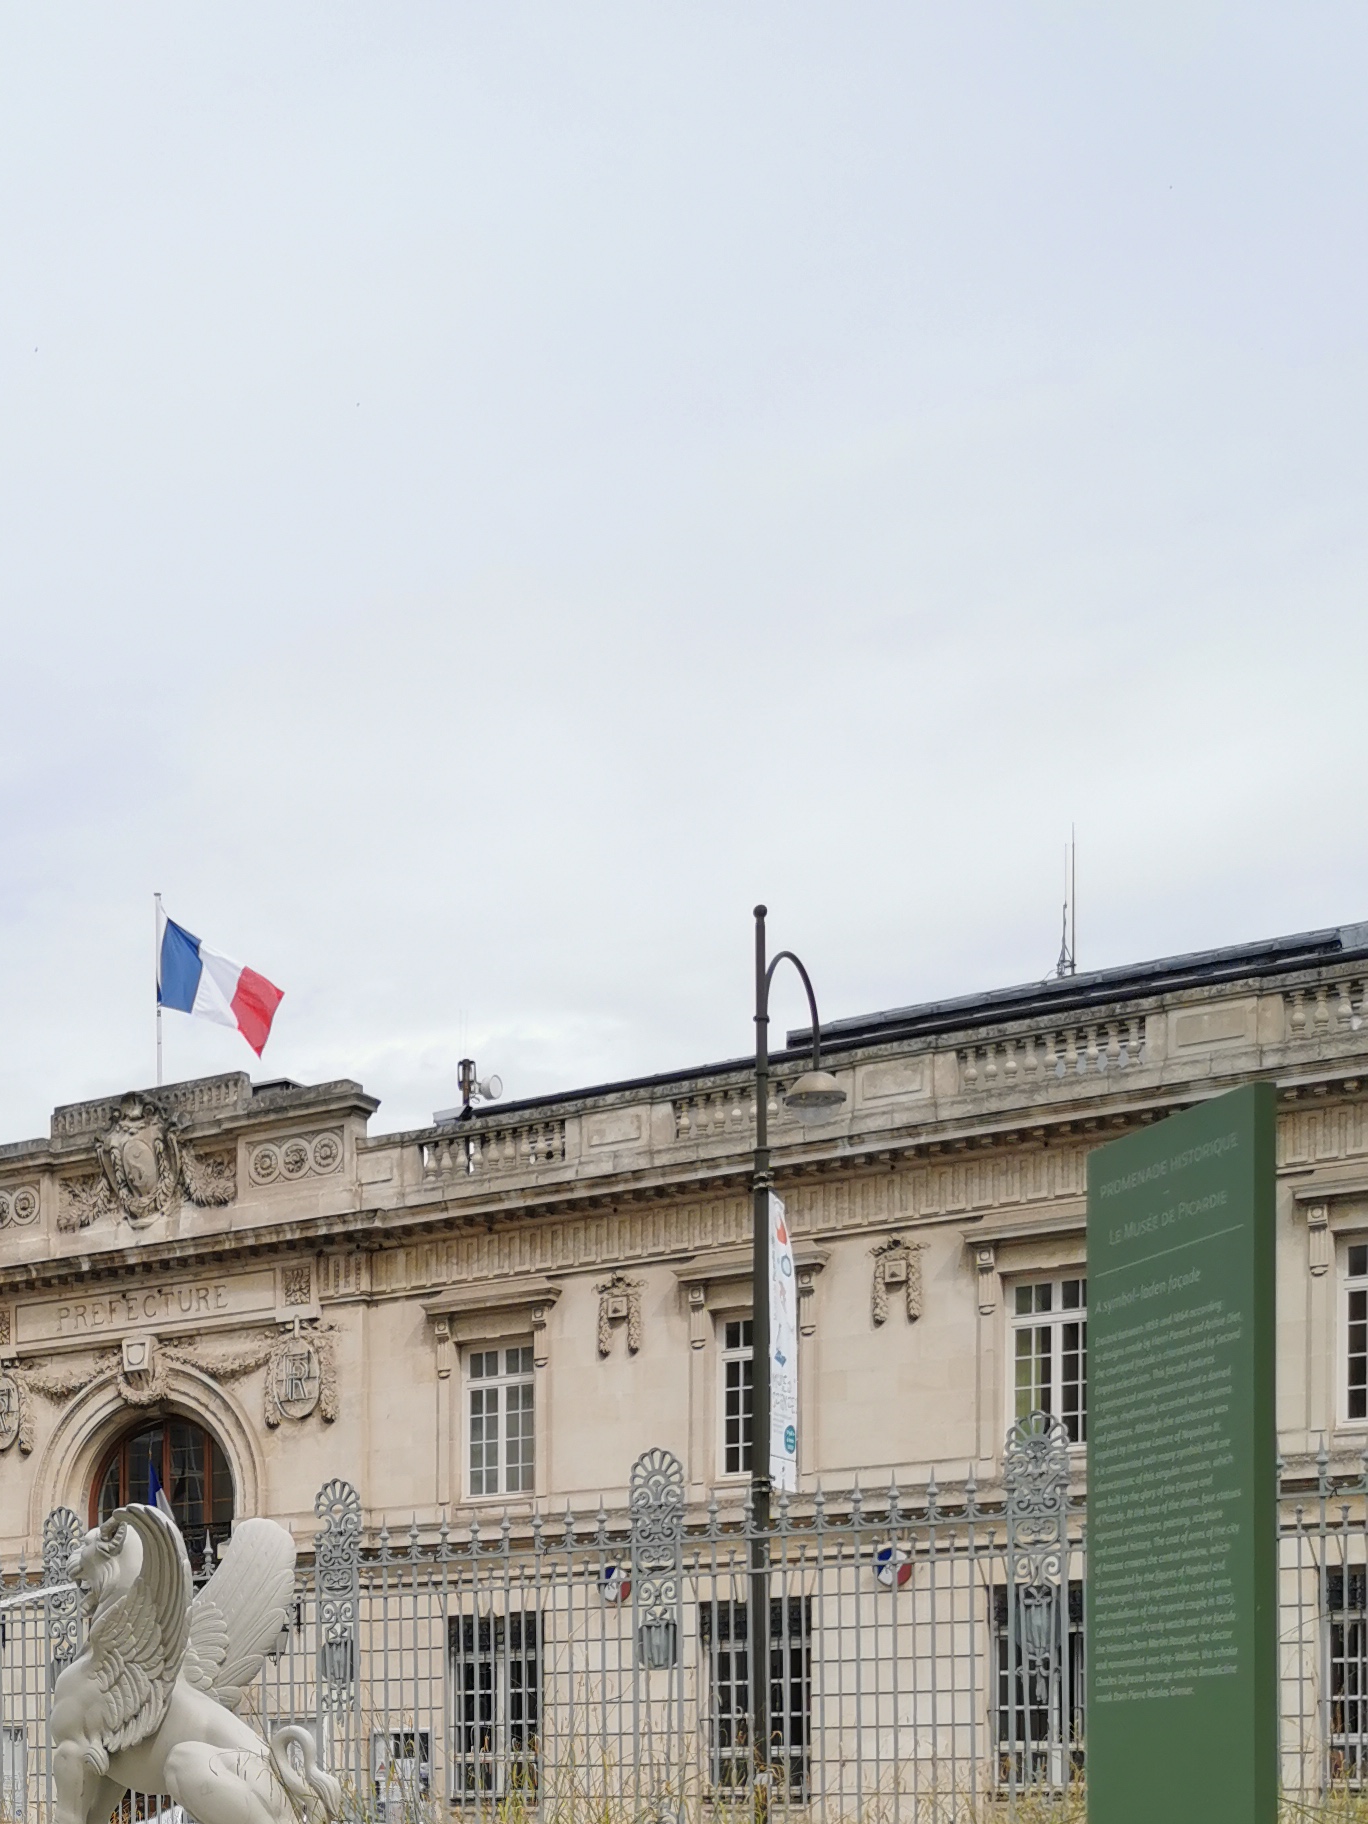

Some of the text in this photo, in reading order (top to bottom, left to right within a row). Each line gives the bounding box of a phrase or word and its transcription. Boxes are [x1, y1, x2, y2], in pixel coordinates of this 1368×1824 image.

[1100, 1132, 1237, 1197] PROMENADE HISTORIQUE
[56, 1284, 229, 1332] PREFECTURE
[1094, 1301, 1102, 1314] A
[1167, 1267, 1201, 1294] façade
